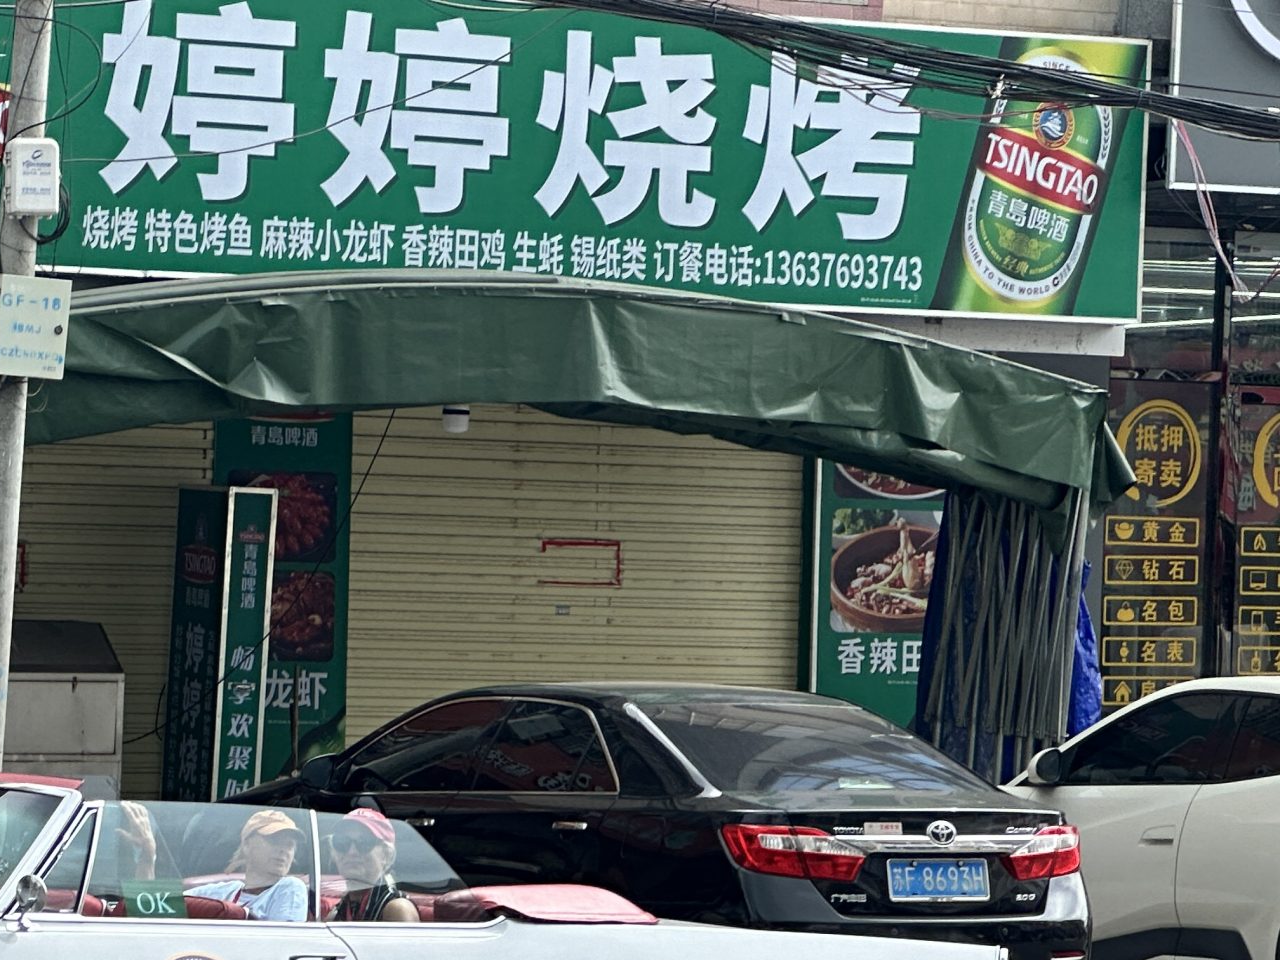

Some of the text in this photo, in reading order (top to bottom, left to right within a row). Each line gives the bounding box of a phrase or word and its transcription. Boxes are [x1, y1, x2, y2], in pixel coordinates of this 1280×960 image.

[98, 0, 922, 242] 婷婷烧烤
[985, 133, 1099, 205] TSINGTAO
[82, 205, 922, 292] 烧烤 特色烤鱼 麻辣小龙虾 香辣田鸡 生蚝 锡纸类 订餐电话:13637693743
[967, 235, 982, 267] CHINA
[983, 266, 995, 280] TO
[996, 278, 1015, 293] THE
[1018, 284, 1051, 296] WORLD
[251, 425, 318, 447] 青岛啤酒
[1135, 423, 1184, 453] 抵押
[1134, 458, 1182, 488] 寄卖
[1142, 521, 1186, 542] 黄金
[240, 544, 258, 608] 青岛啤酒
[1142, 560, 1186, 580] 钻石
[1141, 600, 1185, 622] 名包
[1140, 641, 1184, 662] 名表
[136, 892, 177, 914] OK
